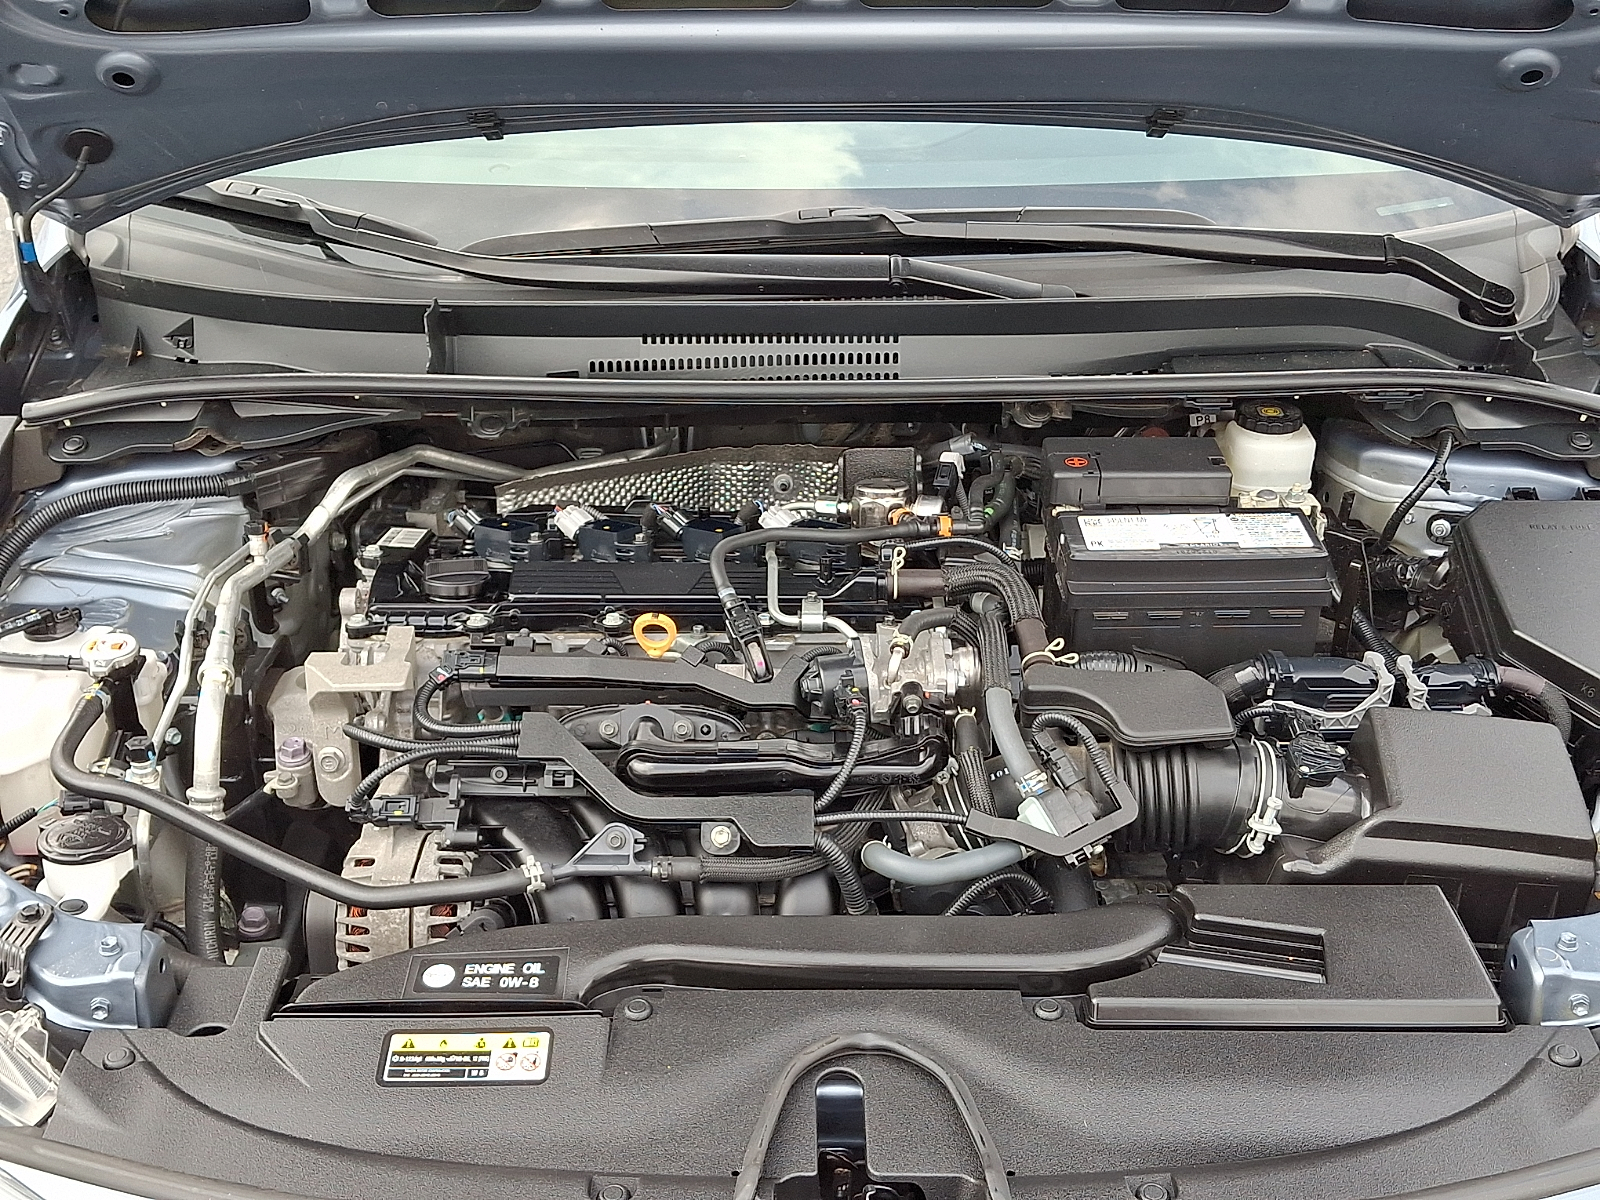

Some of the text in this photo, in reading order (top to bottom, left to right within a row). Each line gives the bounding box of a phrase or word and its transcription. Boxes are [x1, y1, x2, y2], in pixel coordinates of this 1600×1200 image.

[1195, 414, 1211, 426] P8
[203, 920, 219, 960] NICHIRIN
[464, 962, 546, 975] ENGINE OIL
[461, 976, 540, 988] SAE 0W-8
